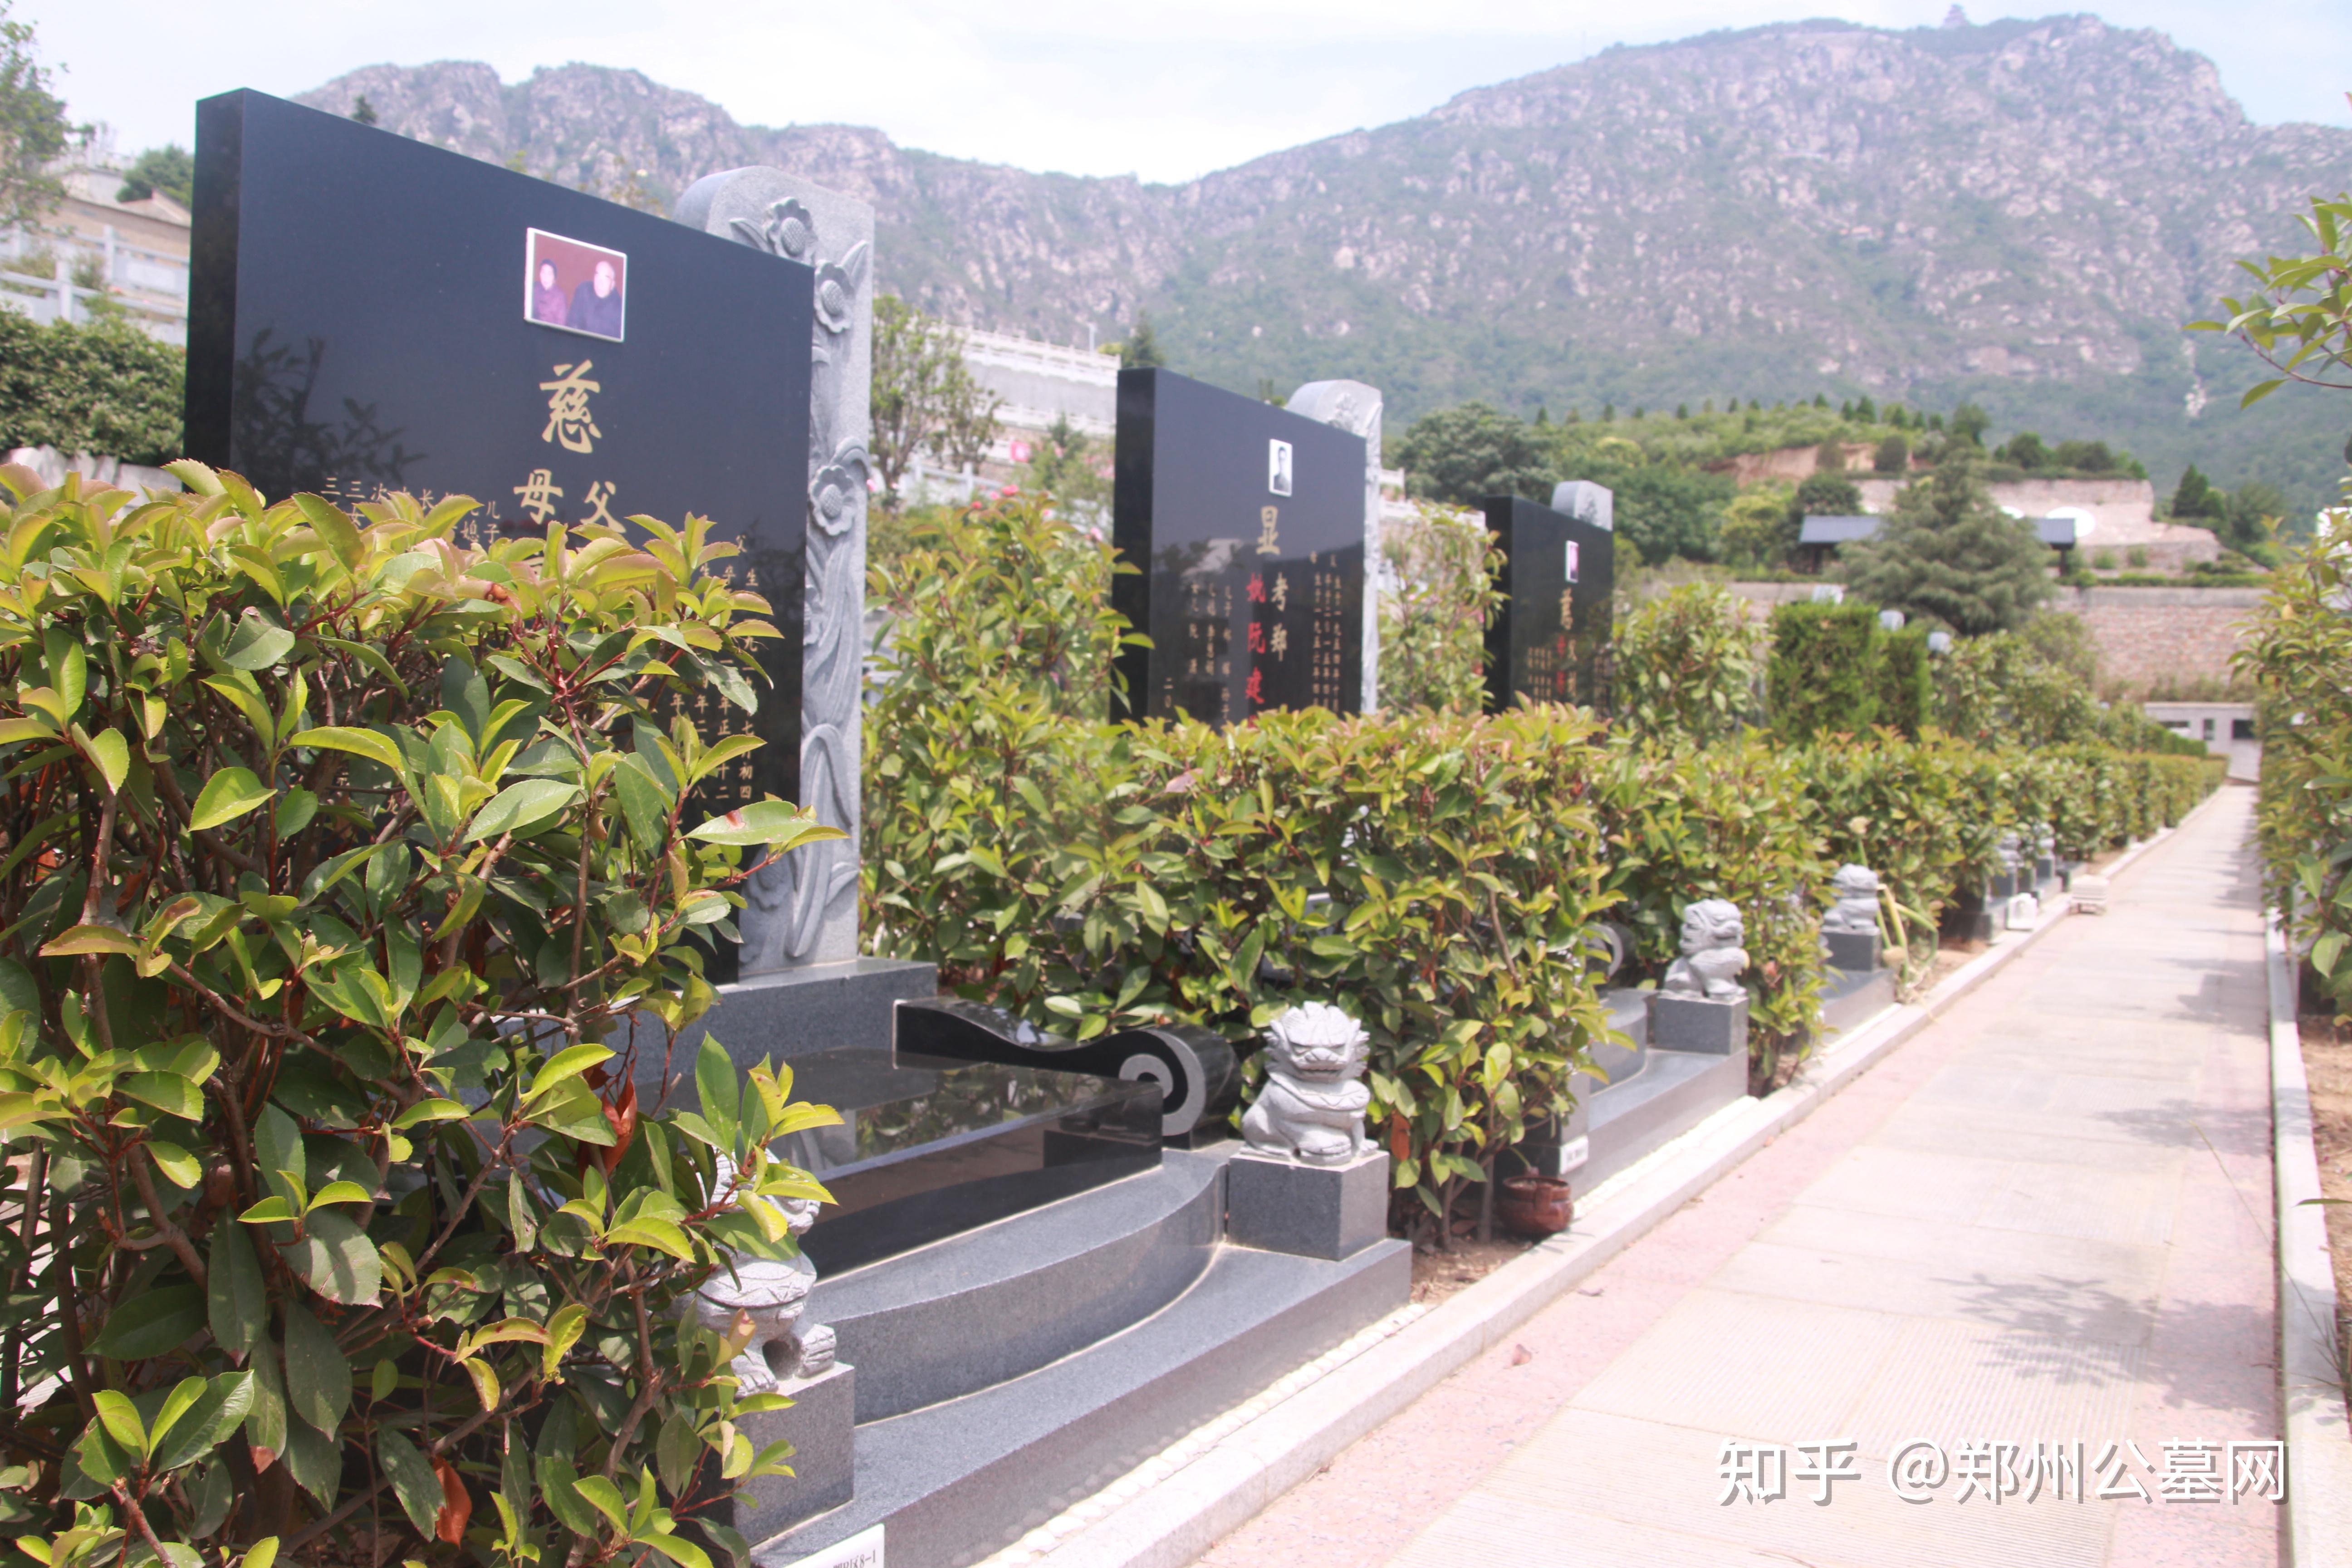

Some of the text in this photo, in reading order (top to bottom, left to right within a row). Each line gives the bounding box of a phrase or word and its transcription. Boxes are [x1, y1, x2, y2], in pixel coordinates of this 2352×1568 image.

[539, 359, 602, 454] 慈
[483, 501, 501, 544] 儿子
[513, 468, 564, 525] 母
[579, 480, 627, 534] 父
[1255, 505, 1281, 555] 显
